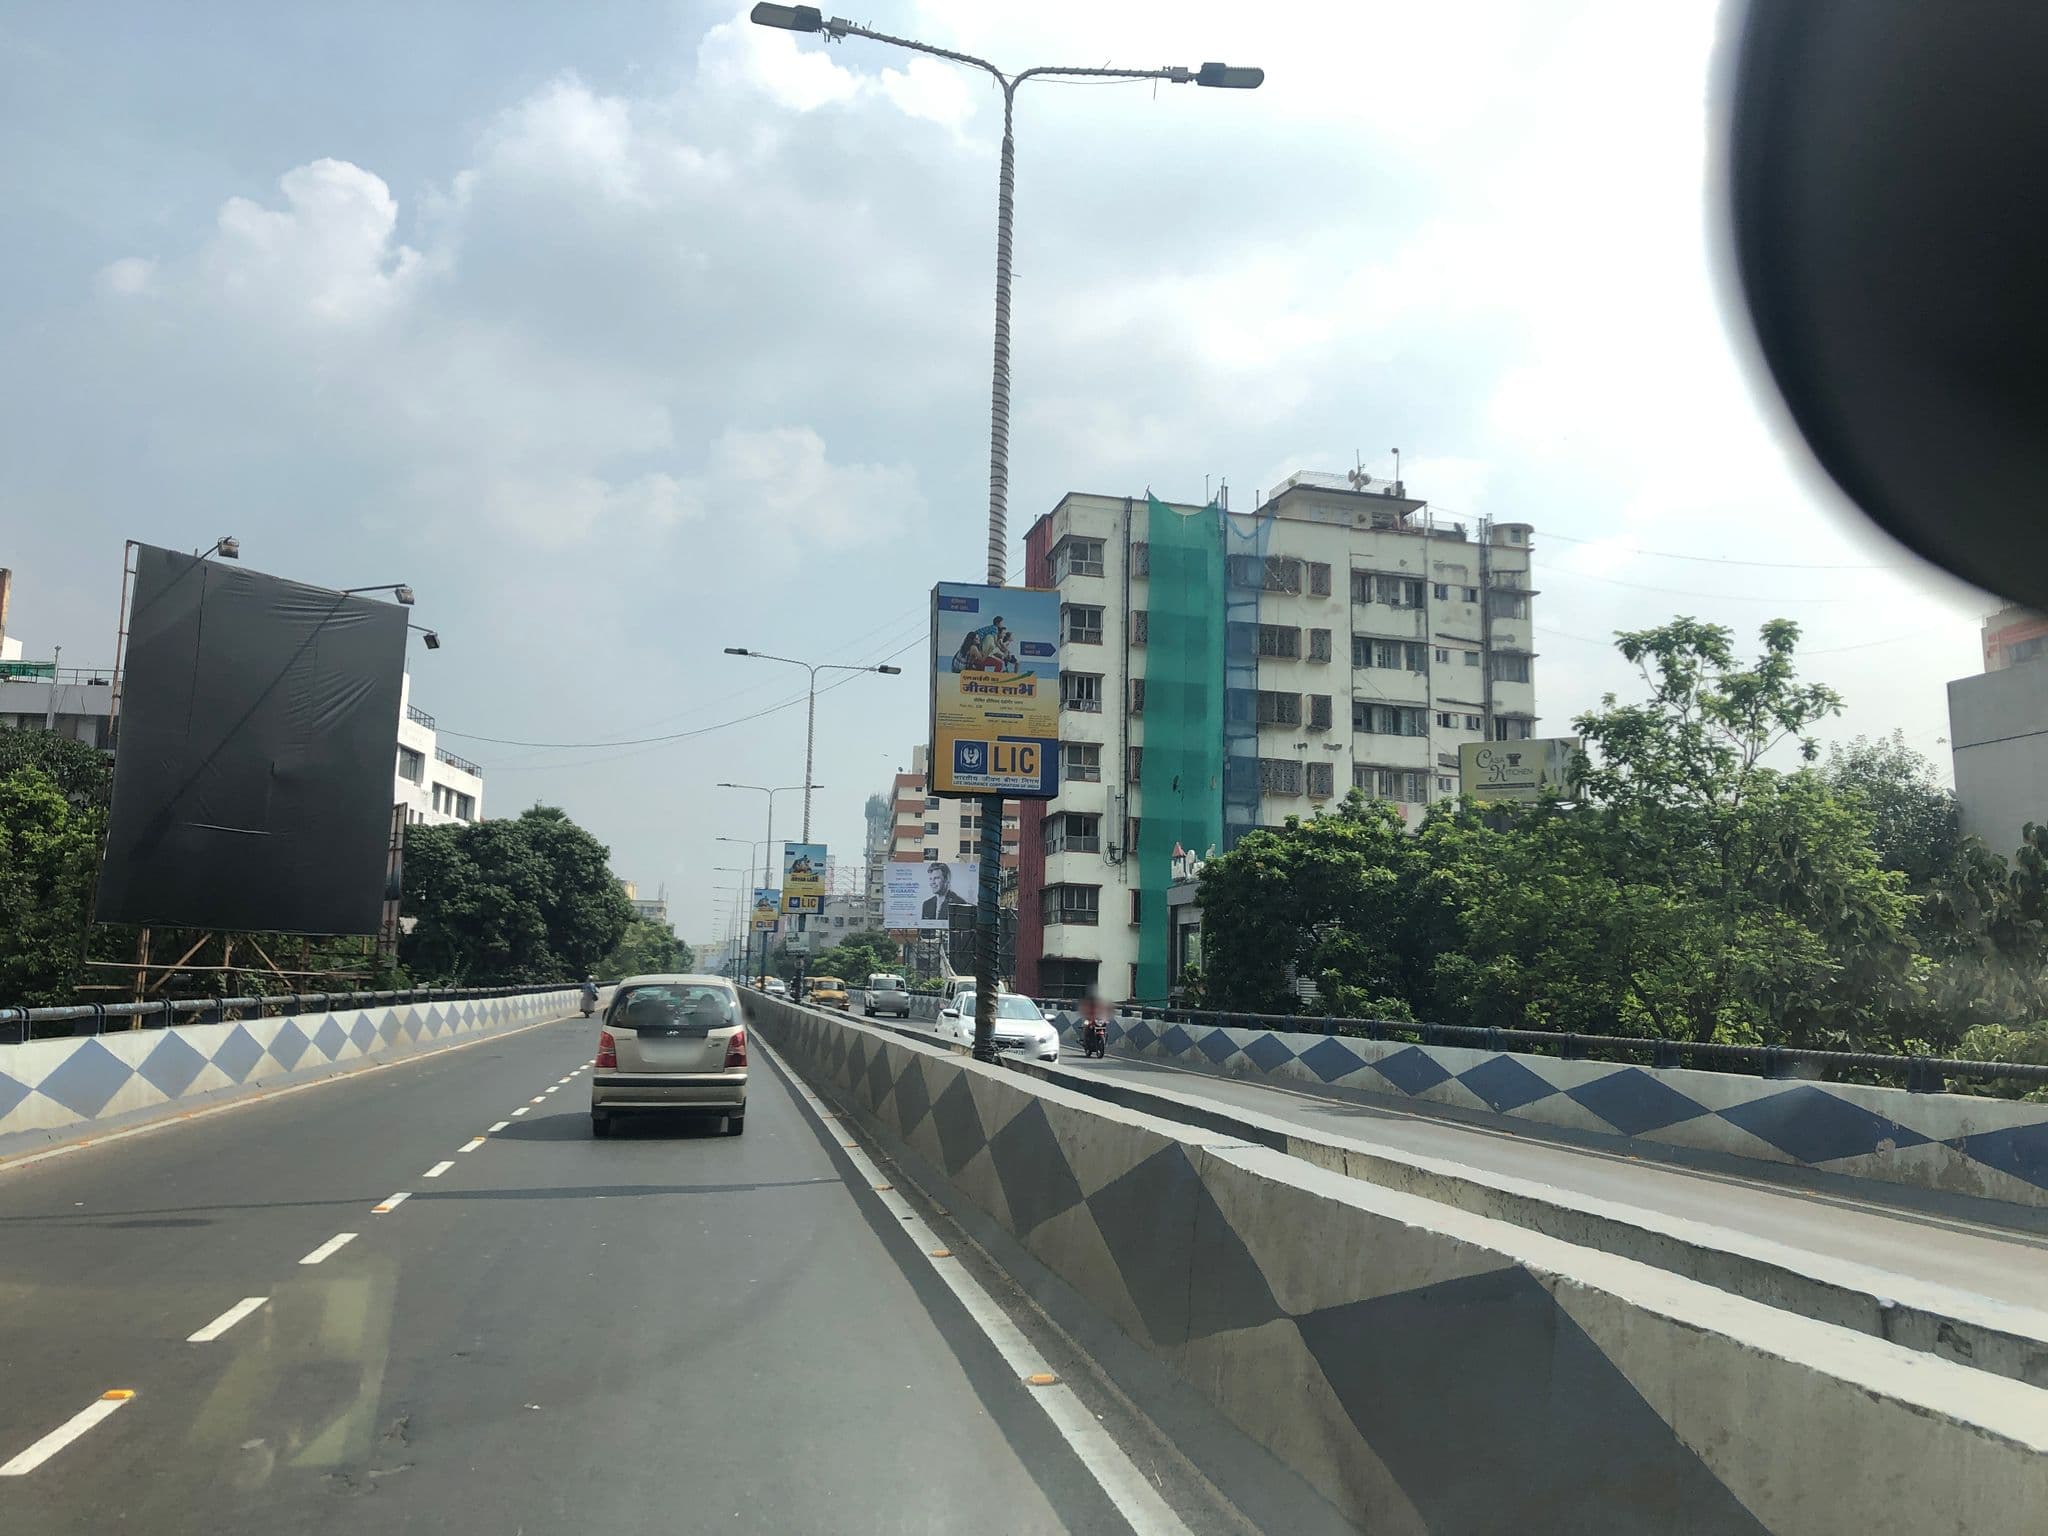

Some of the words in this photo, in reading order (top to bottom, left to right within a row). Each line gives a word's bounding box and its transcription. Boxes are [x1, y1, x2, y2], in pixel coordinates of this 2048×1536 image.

[962, 681, 999, 694] जीवन
[1001, 683, 1035, 696] लाभ
[994, 746, 1034, 774] LIC
[802, 898, 817, 908] LIC
